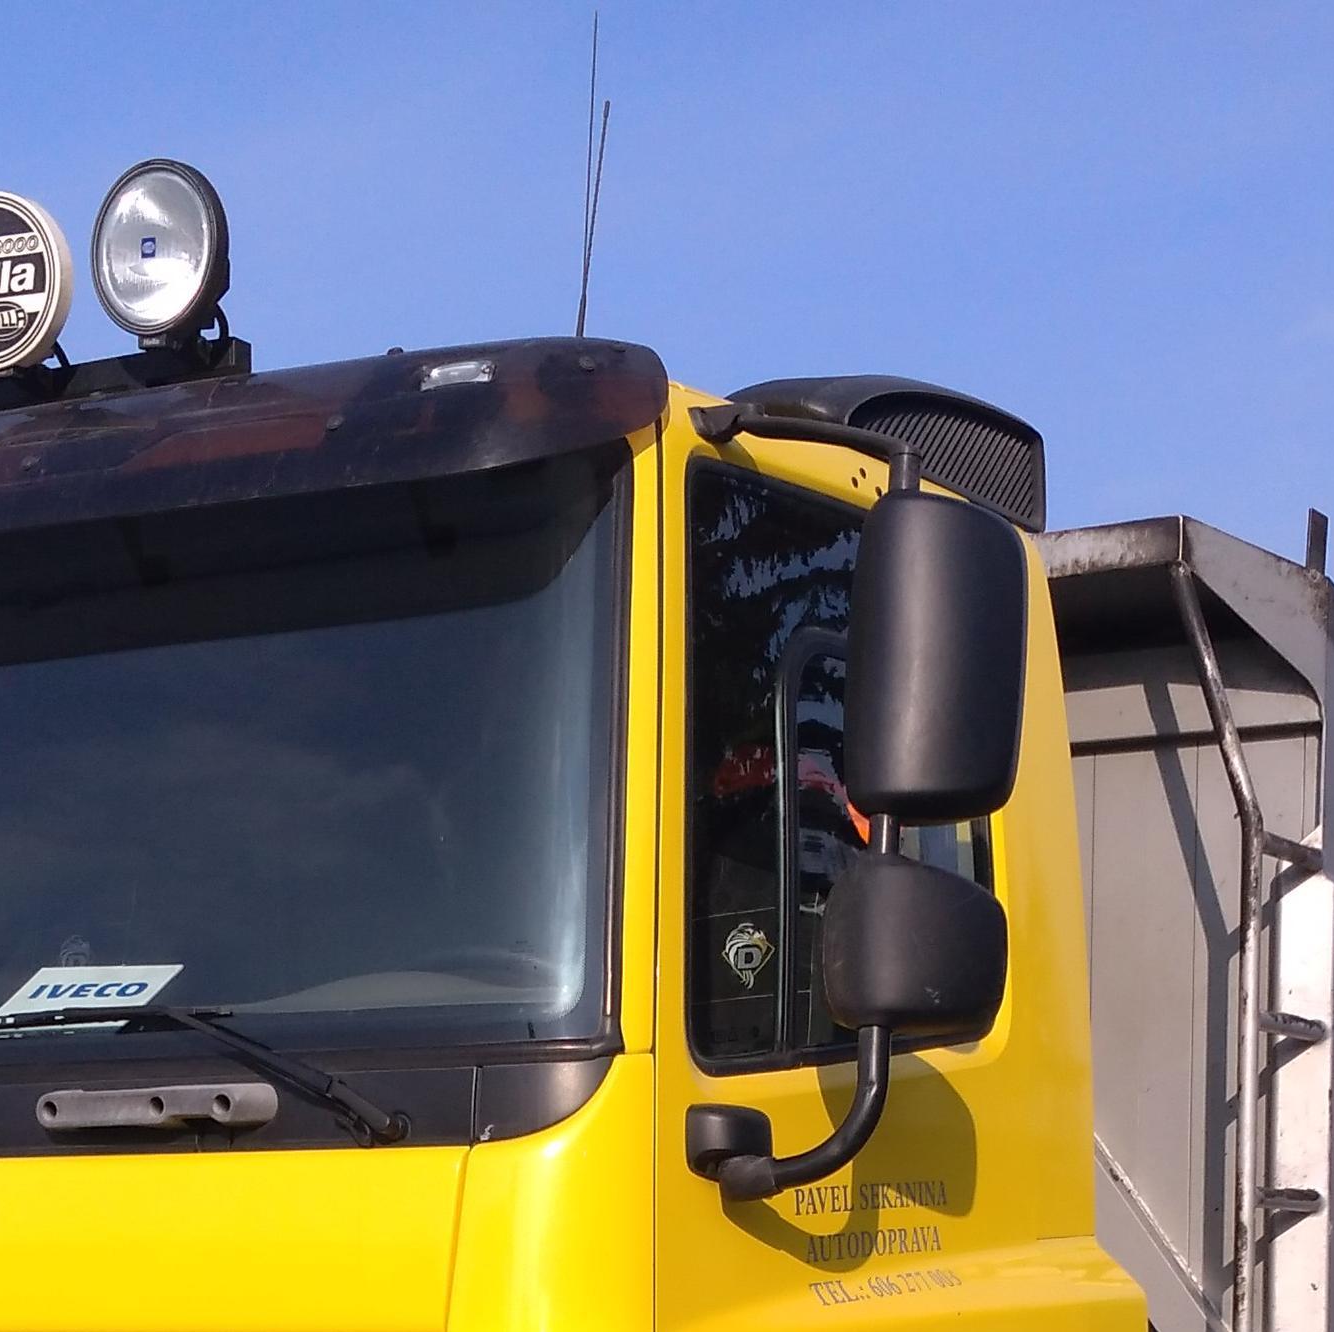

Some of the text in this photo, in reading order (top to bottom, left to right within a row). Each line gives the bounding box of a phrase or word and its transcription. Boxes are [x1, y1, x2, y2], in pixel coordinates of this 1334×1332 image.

[28, 982, 149, 999] IVECO
[794, 1180, 948, 1216] PAVEL SEKANINA
[805, 1225, 943, 1264] AUTODOPRAVA
